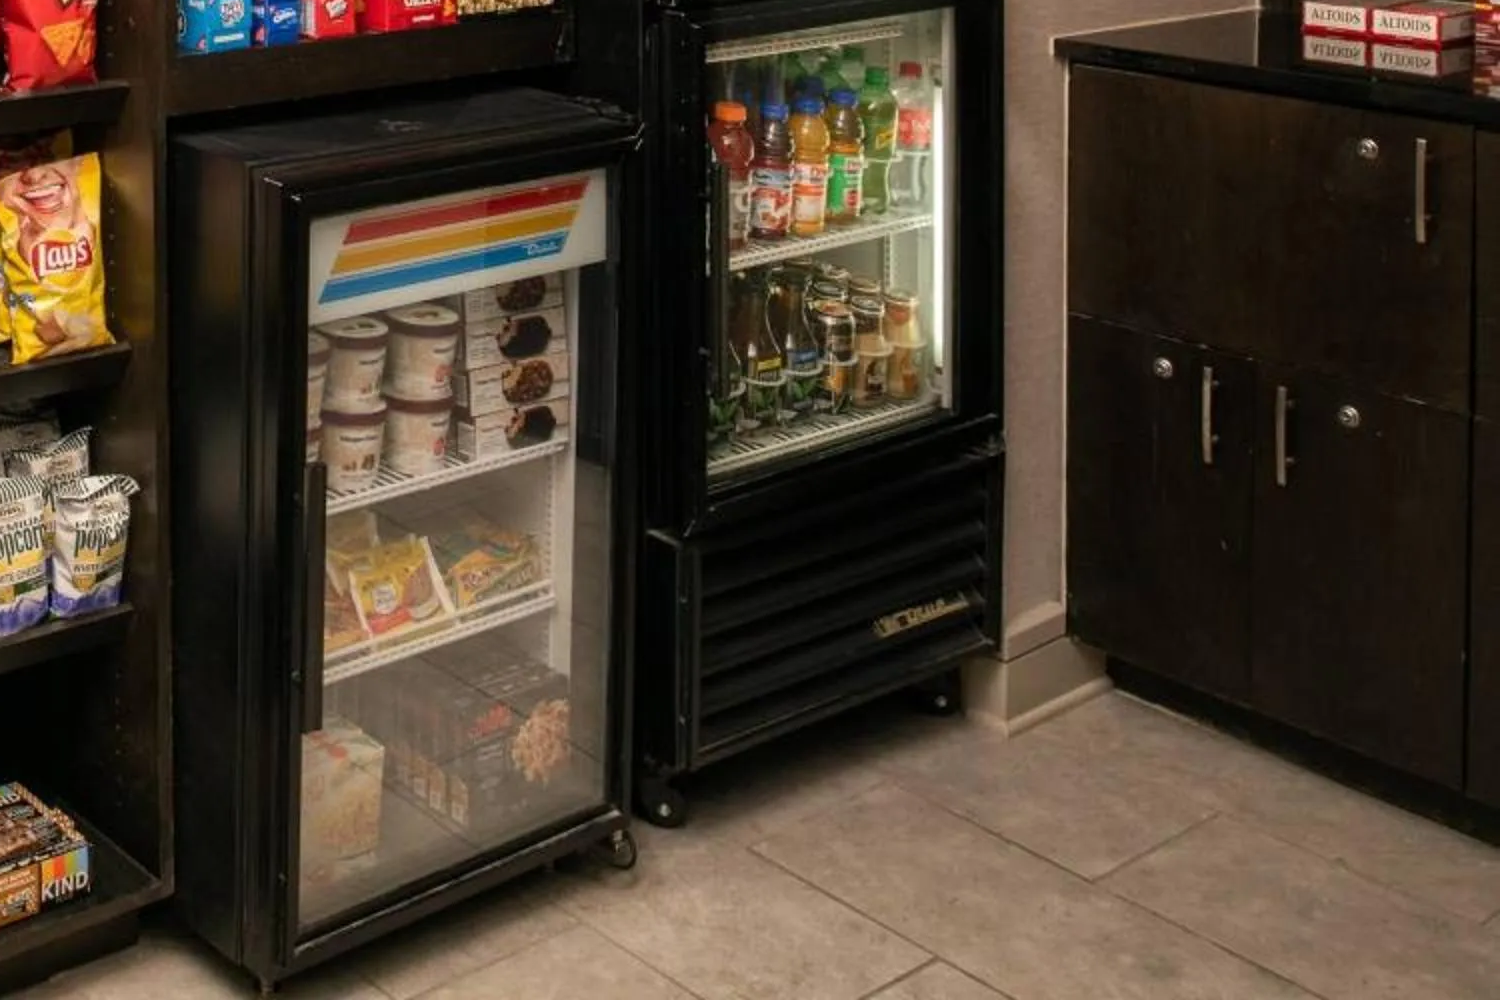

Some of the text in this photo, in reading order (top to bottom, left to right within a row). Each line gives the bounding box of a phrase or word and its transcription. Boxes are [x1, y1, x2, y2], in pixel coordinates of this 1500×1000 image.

[1311, 7, 1361, 25] ALTOIDS
[1379, 15, 1432, 33] ALTOIDS
[38, 236, 92, 276] Lay's
[41, 871, 89, 901] KIND
